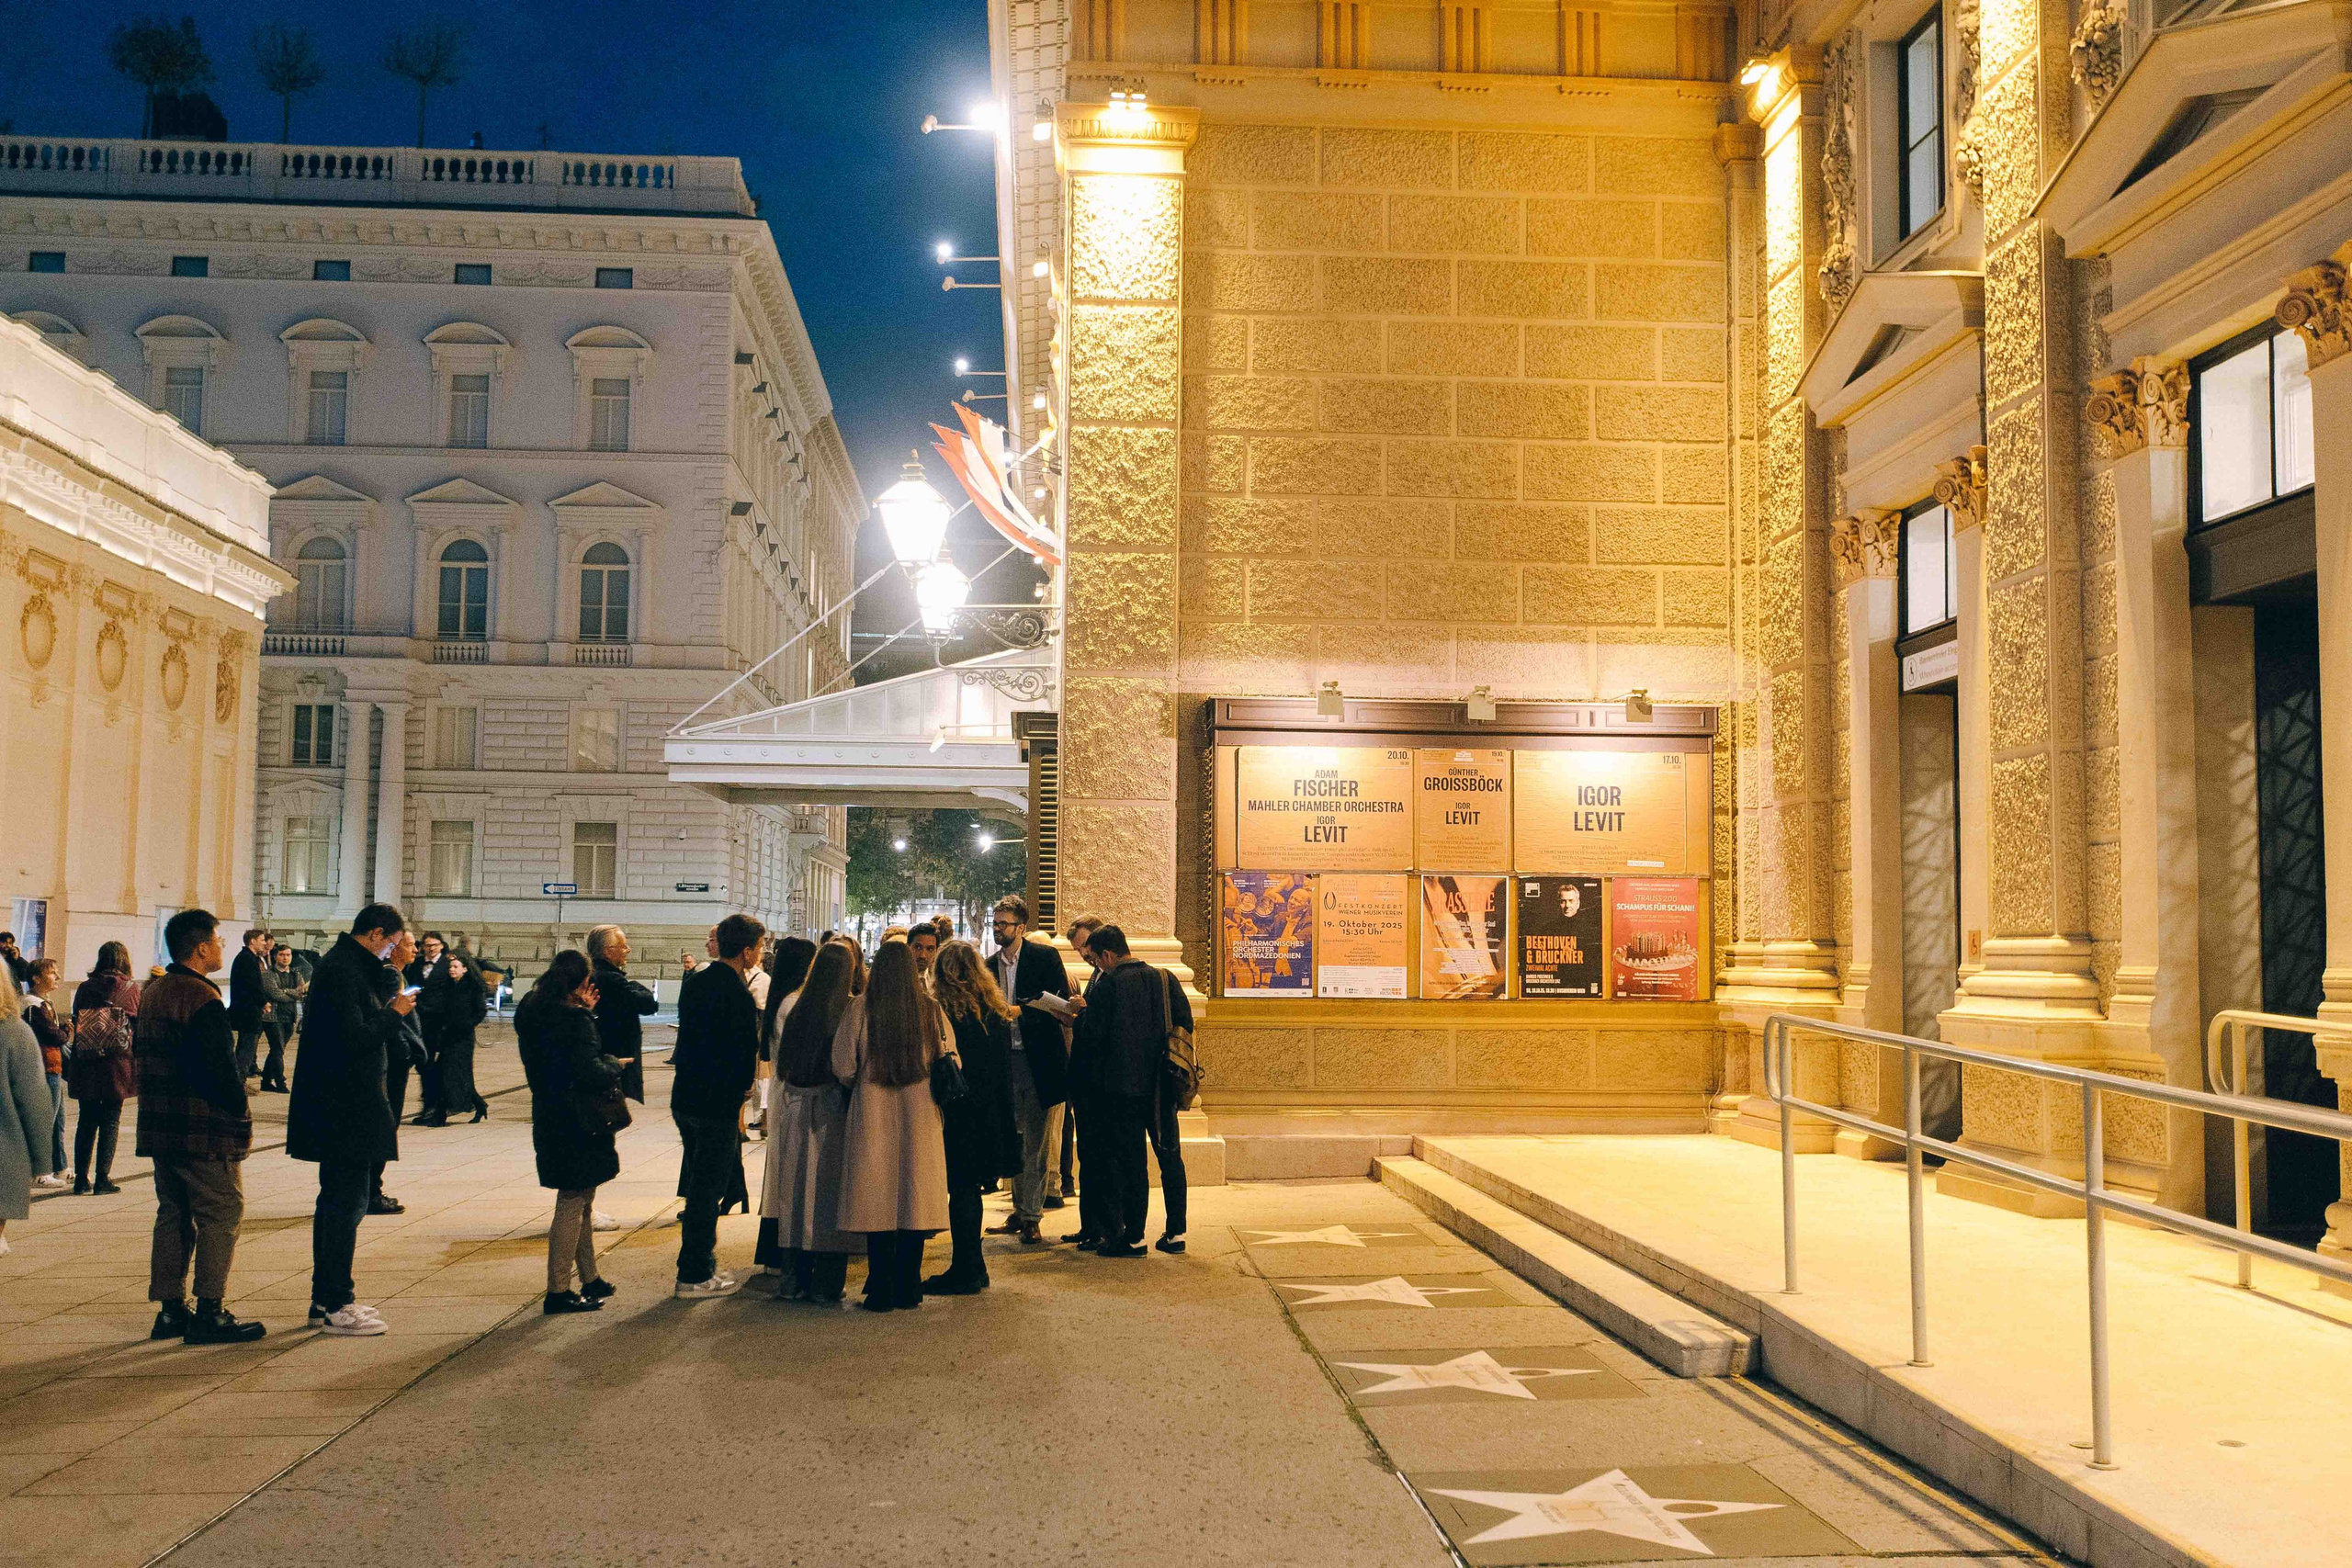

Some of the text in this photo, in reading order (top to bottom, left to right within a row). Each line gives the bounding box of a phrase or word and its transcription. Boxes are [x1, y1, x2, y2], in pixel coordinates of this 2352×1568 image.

[1387, 750, 1409, 760] 20.10.
[1662, 756, 1681, 764] 17.10.
[1315, 770, 1338, 778] ADAM
[1448, 767, 1478, 776] GÜNTHER
[1294, 779, 1359, 797] FISCHER
[1424, 776, 1503, 792] GROISSBÖCK
[1577, 786, 1621, 806] IGOR
[1248, 800, 1404, 812] MAHLER CHAMBER ORCHESTRA
[1317, 816, 1336, 824] IGOR
[1446, 811, 1480, 825] LEVIT
[1574, 812, 1625, 832] LEVIT
[1304, 826, 1348, 843] LEVIT
[1653, 903, 1667, 911] FÜR
[1526, 936, 1577, 949] BEETHOVEN
[1526, 951, 1583, 964] & BRUCKNER
